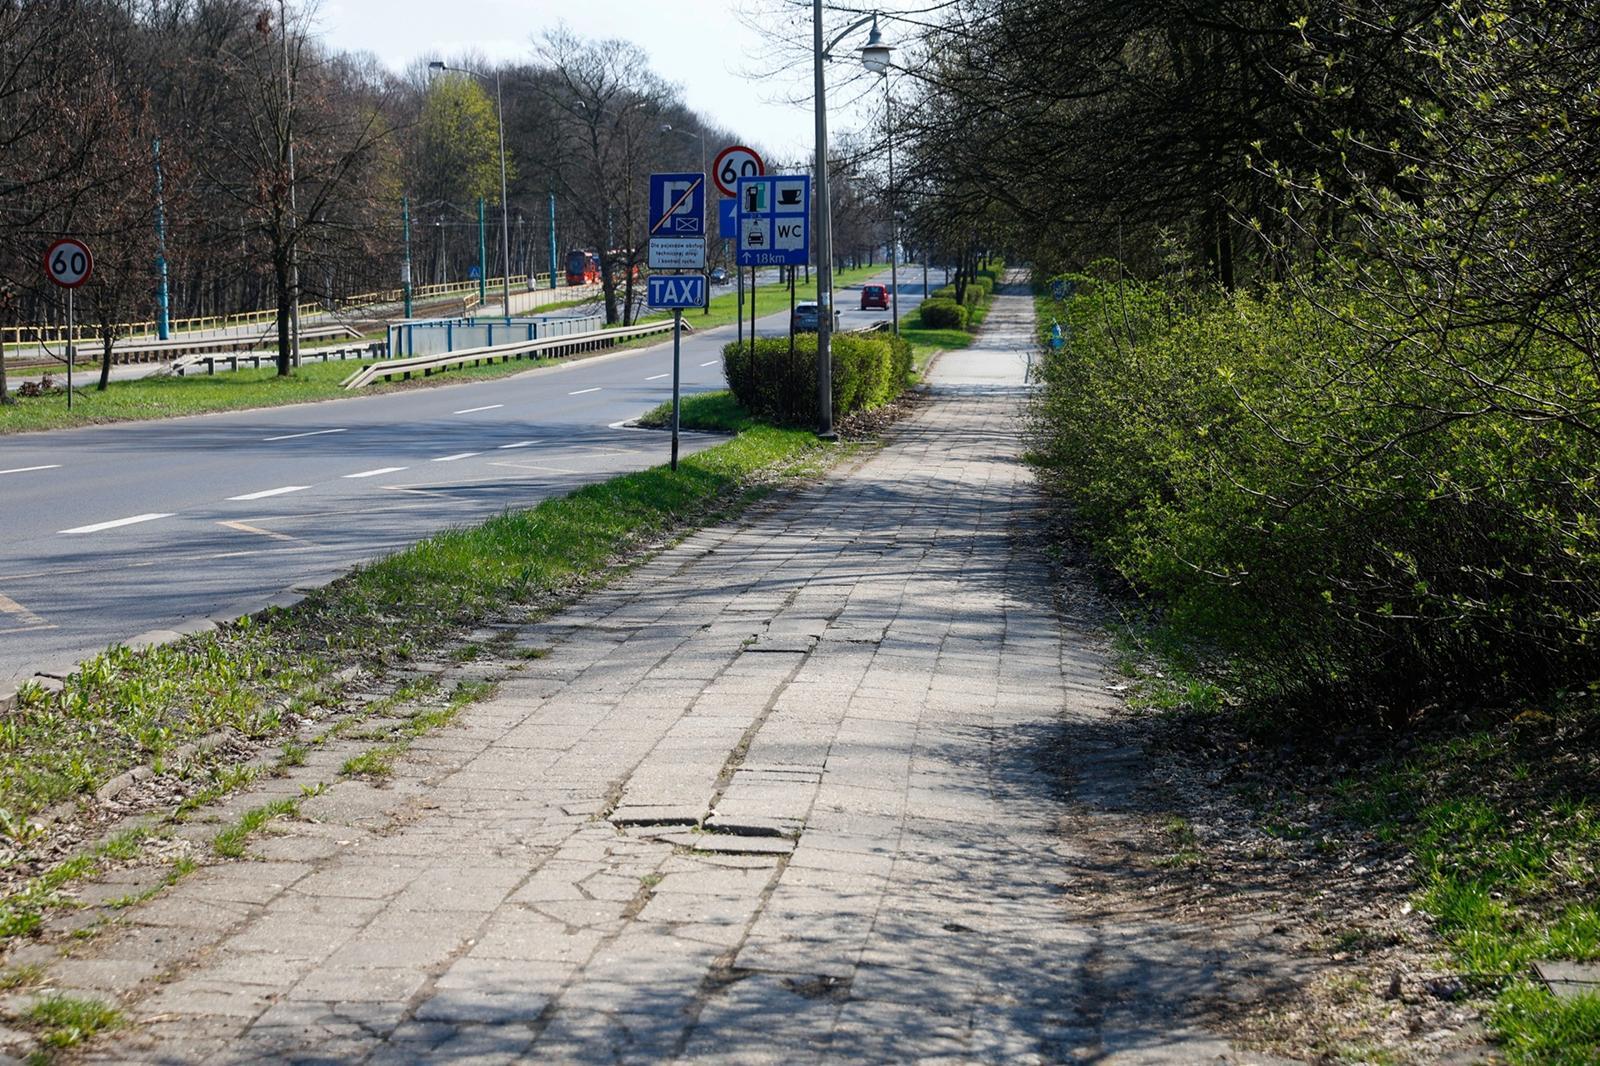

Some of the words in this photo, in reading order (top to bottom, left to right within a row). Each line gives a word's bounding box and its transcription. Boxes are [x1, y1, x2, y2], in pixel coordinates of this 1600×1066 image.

[721, 159, 757, 184] 60
[663, 181, 693, 228] P
[778, 225, 802, 238] WC
[52, 250, 86, 275] 60
[650, 280, 702, 304] TAXI
